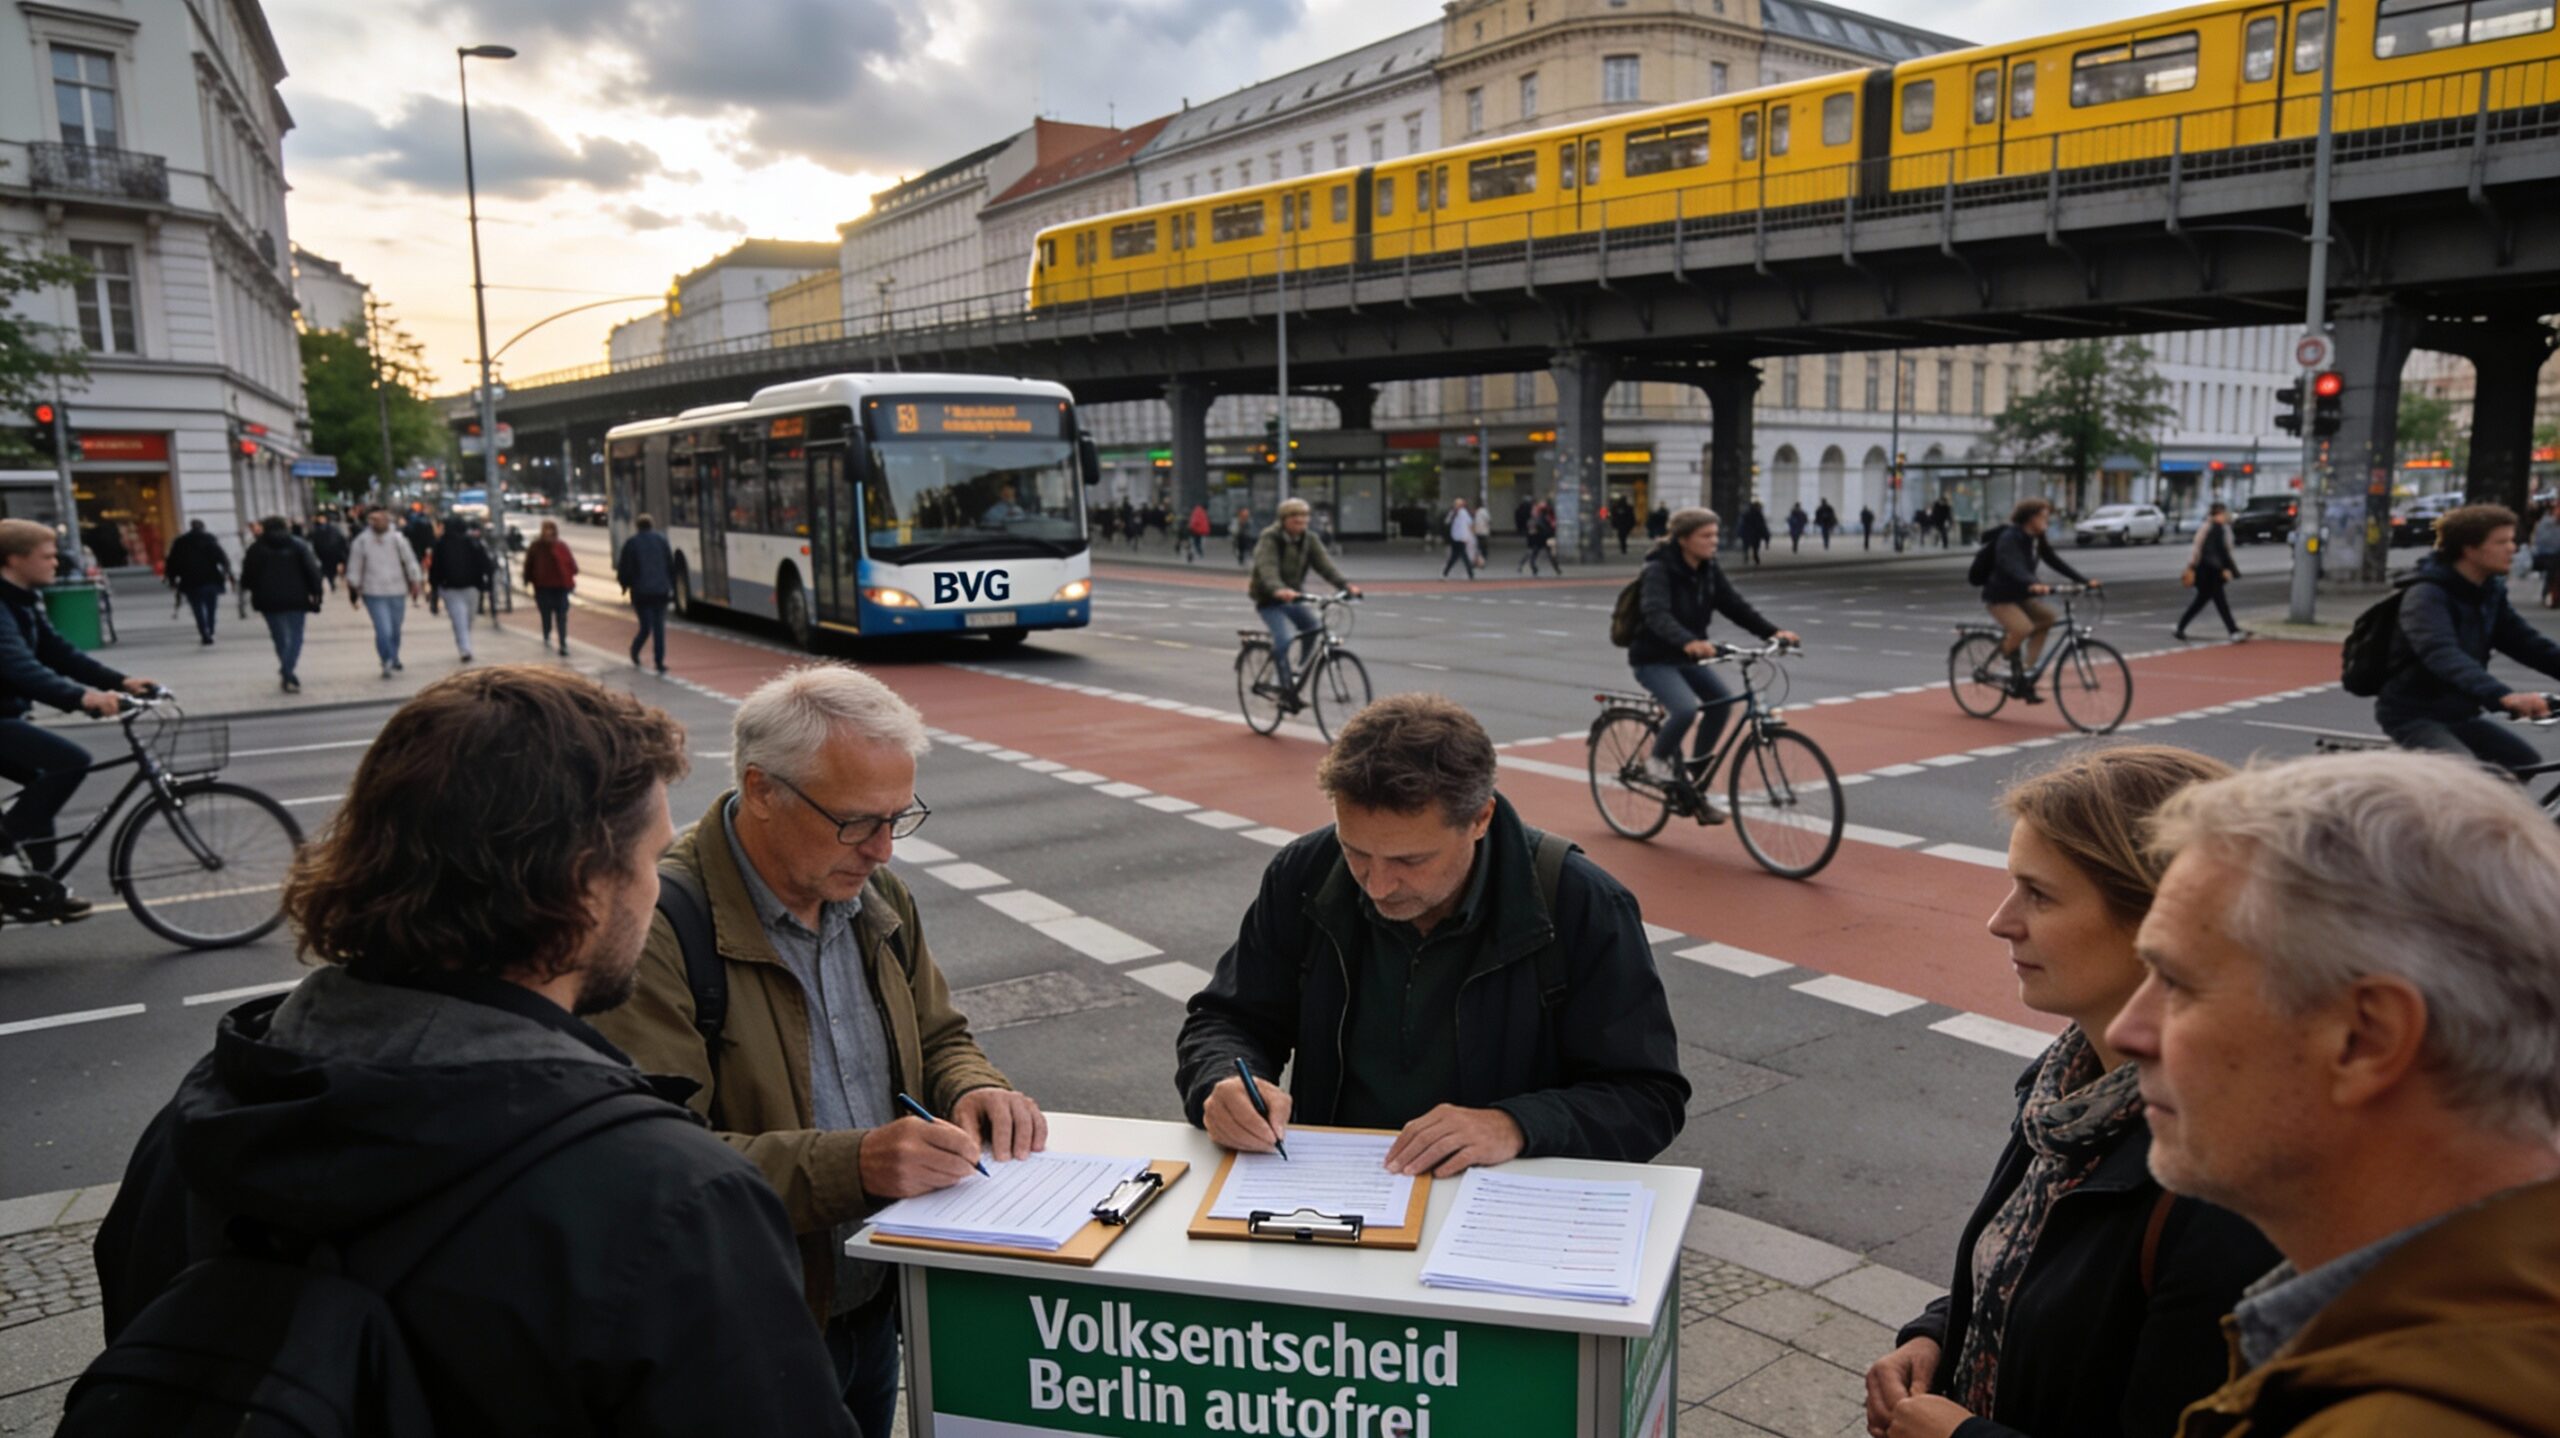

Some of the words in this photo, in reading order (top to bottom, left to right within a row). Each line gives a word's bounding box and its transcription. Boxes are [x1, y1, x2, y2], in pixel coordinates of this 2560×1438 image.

[933, 569, 1010, 604] BVG
[1028, 1295, 1459, 1387] Volksentscheid
[1028, 1358, 1187, 1426] Berlin
[1204, 1386, 1431, 1438] autofrei
